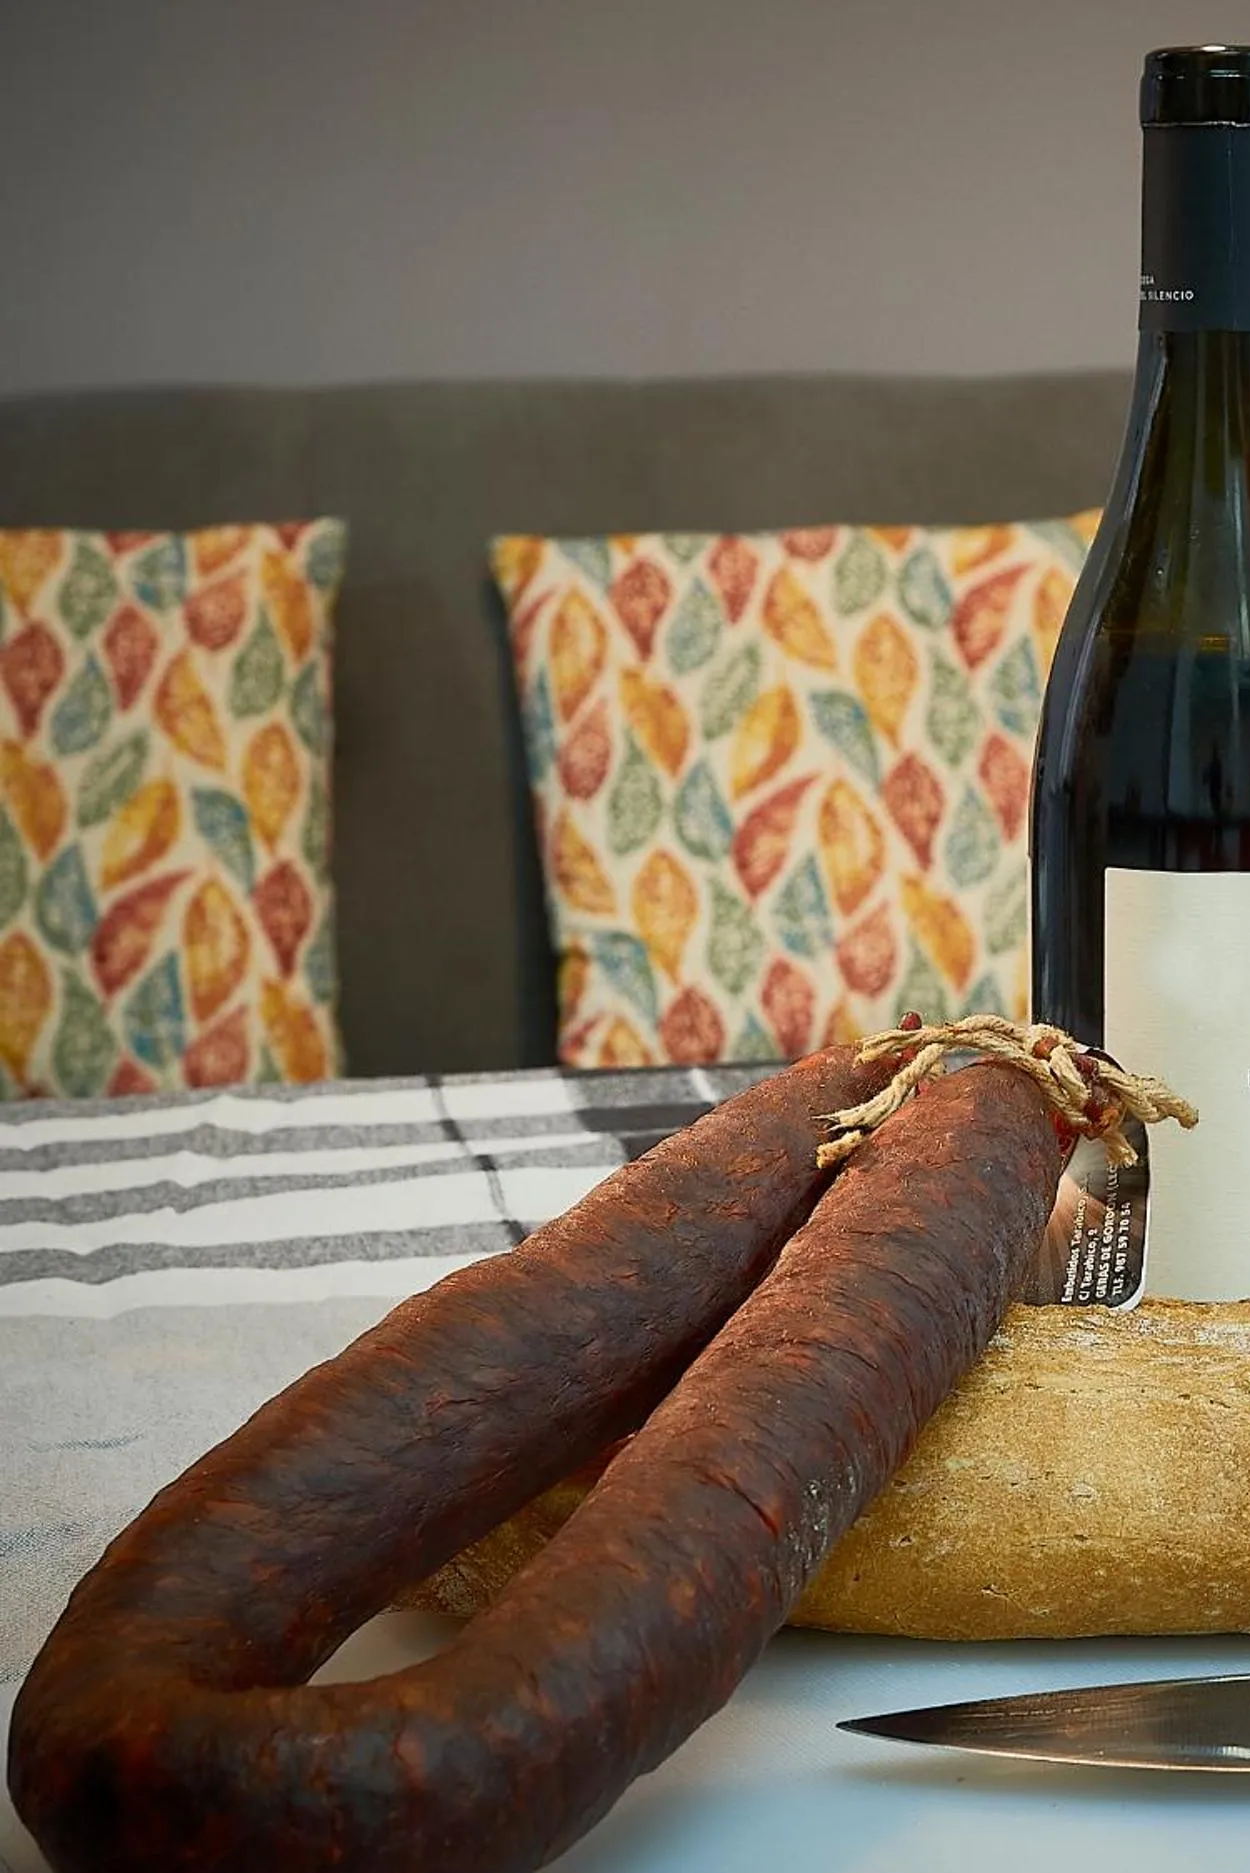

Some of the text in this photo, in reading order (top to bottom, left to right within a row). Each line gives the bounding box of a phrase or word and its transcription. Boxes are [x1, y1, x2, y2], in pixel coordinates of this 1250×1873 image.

[1148, 290, 1194, 301] SILENCIO
[1101, 1245, 1112, 1261] DE
[1114, 1252, 1127, 1272] 987
[1061, 1247, 1080, 1303] Embutidos
